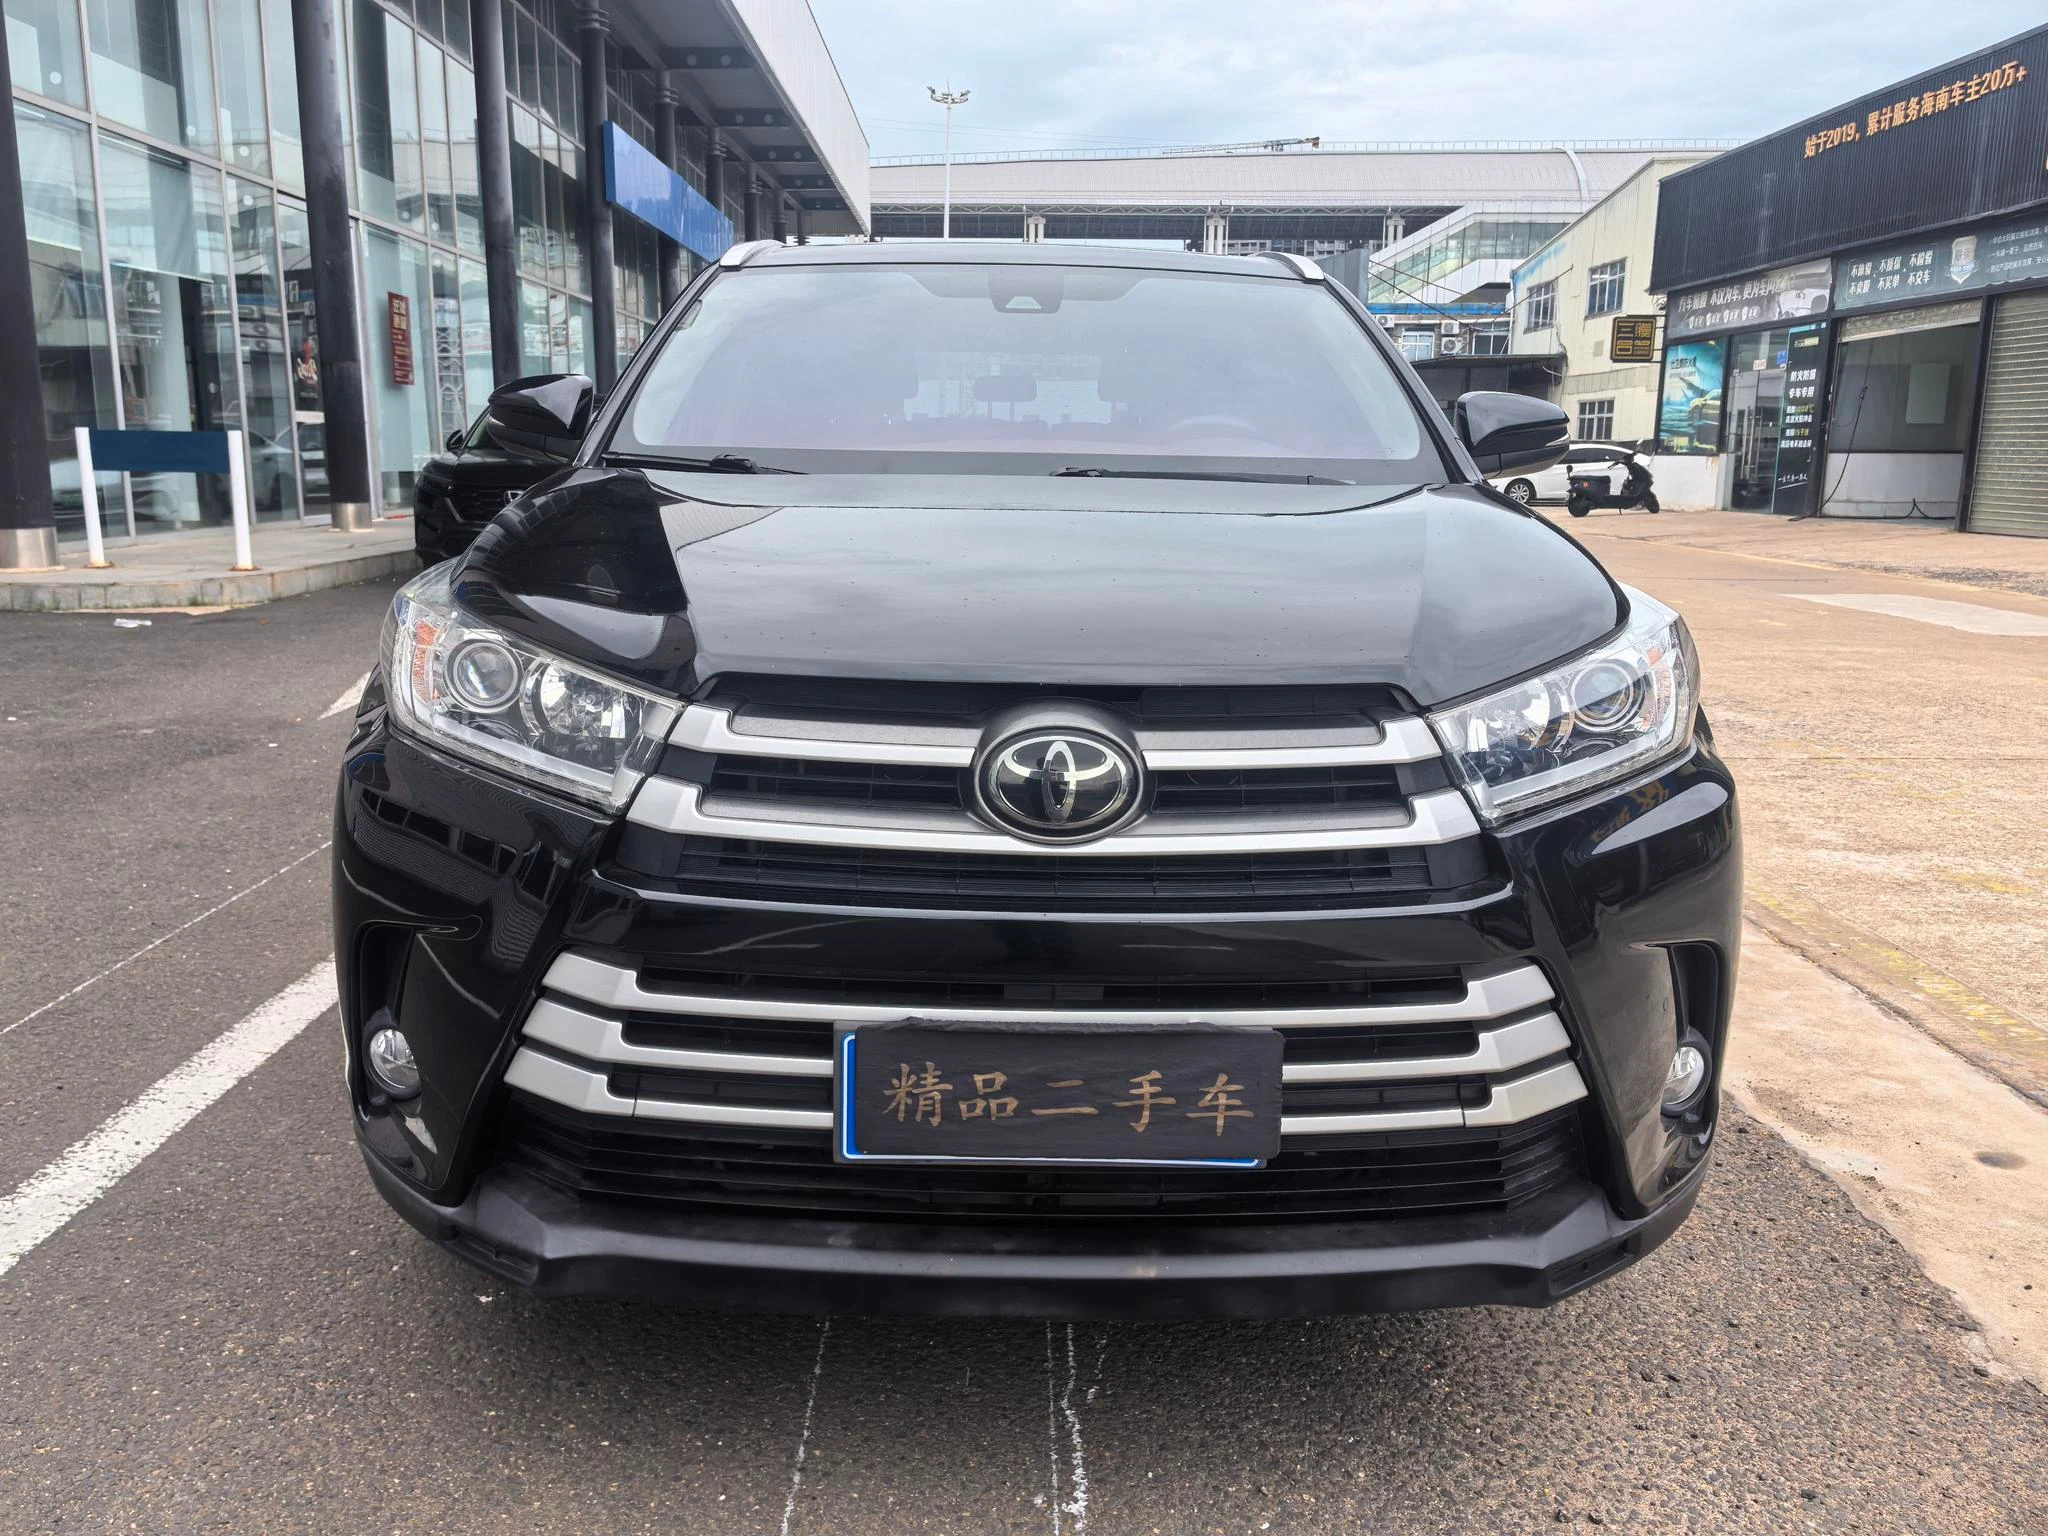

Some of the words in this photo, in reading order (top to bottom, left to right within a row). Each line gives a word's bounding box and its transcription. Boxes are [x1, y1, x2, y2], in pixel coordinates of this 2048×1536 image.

[1907, 269, 1932, 286] 不交车
[882, 1060, 1255, 1137] 精品二手车
